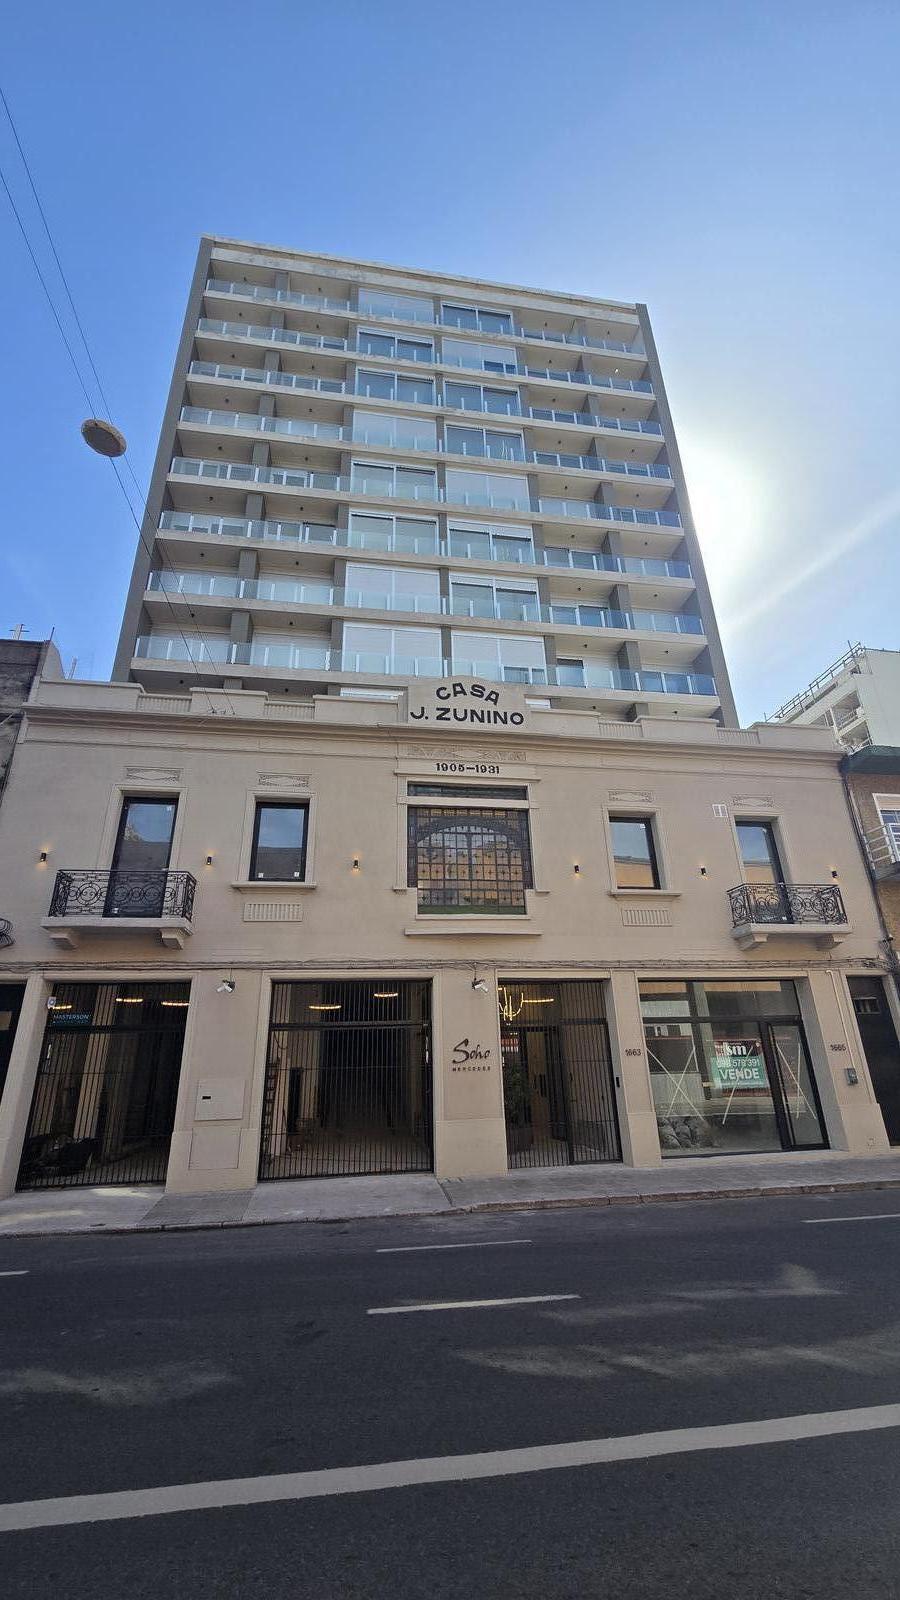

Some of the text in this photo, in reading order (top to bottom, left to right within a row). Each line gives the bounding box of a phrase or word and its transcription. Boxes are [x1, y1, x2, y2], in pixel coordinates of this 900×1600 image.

[436, 683, 499, 705] CASA
[410, 707, 524, 725] J. ZUNINO
[452, 1038, 491, 1064] Soho
[719, 1068, 760, 1080] VENDE
